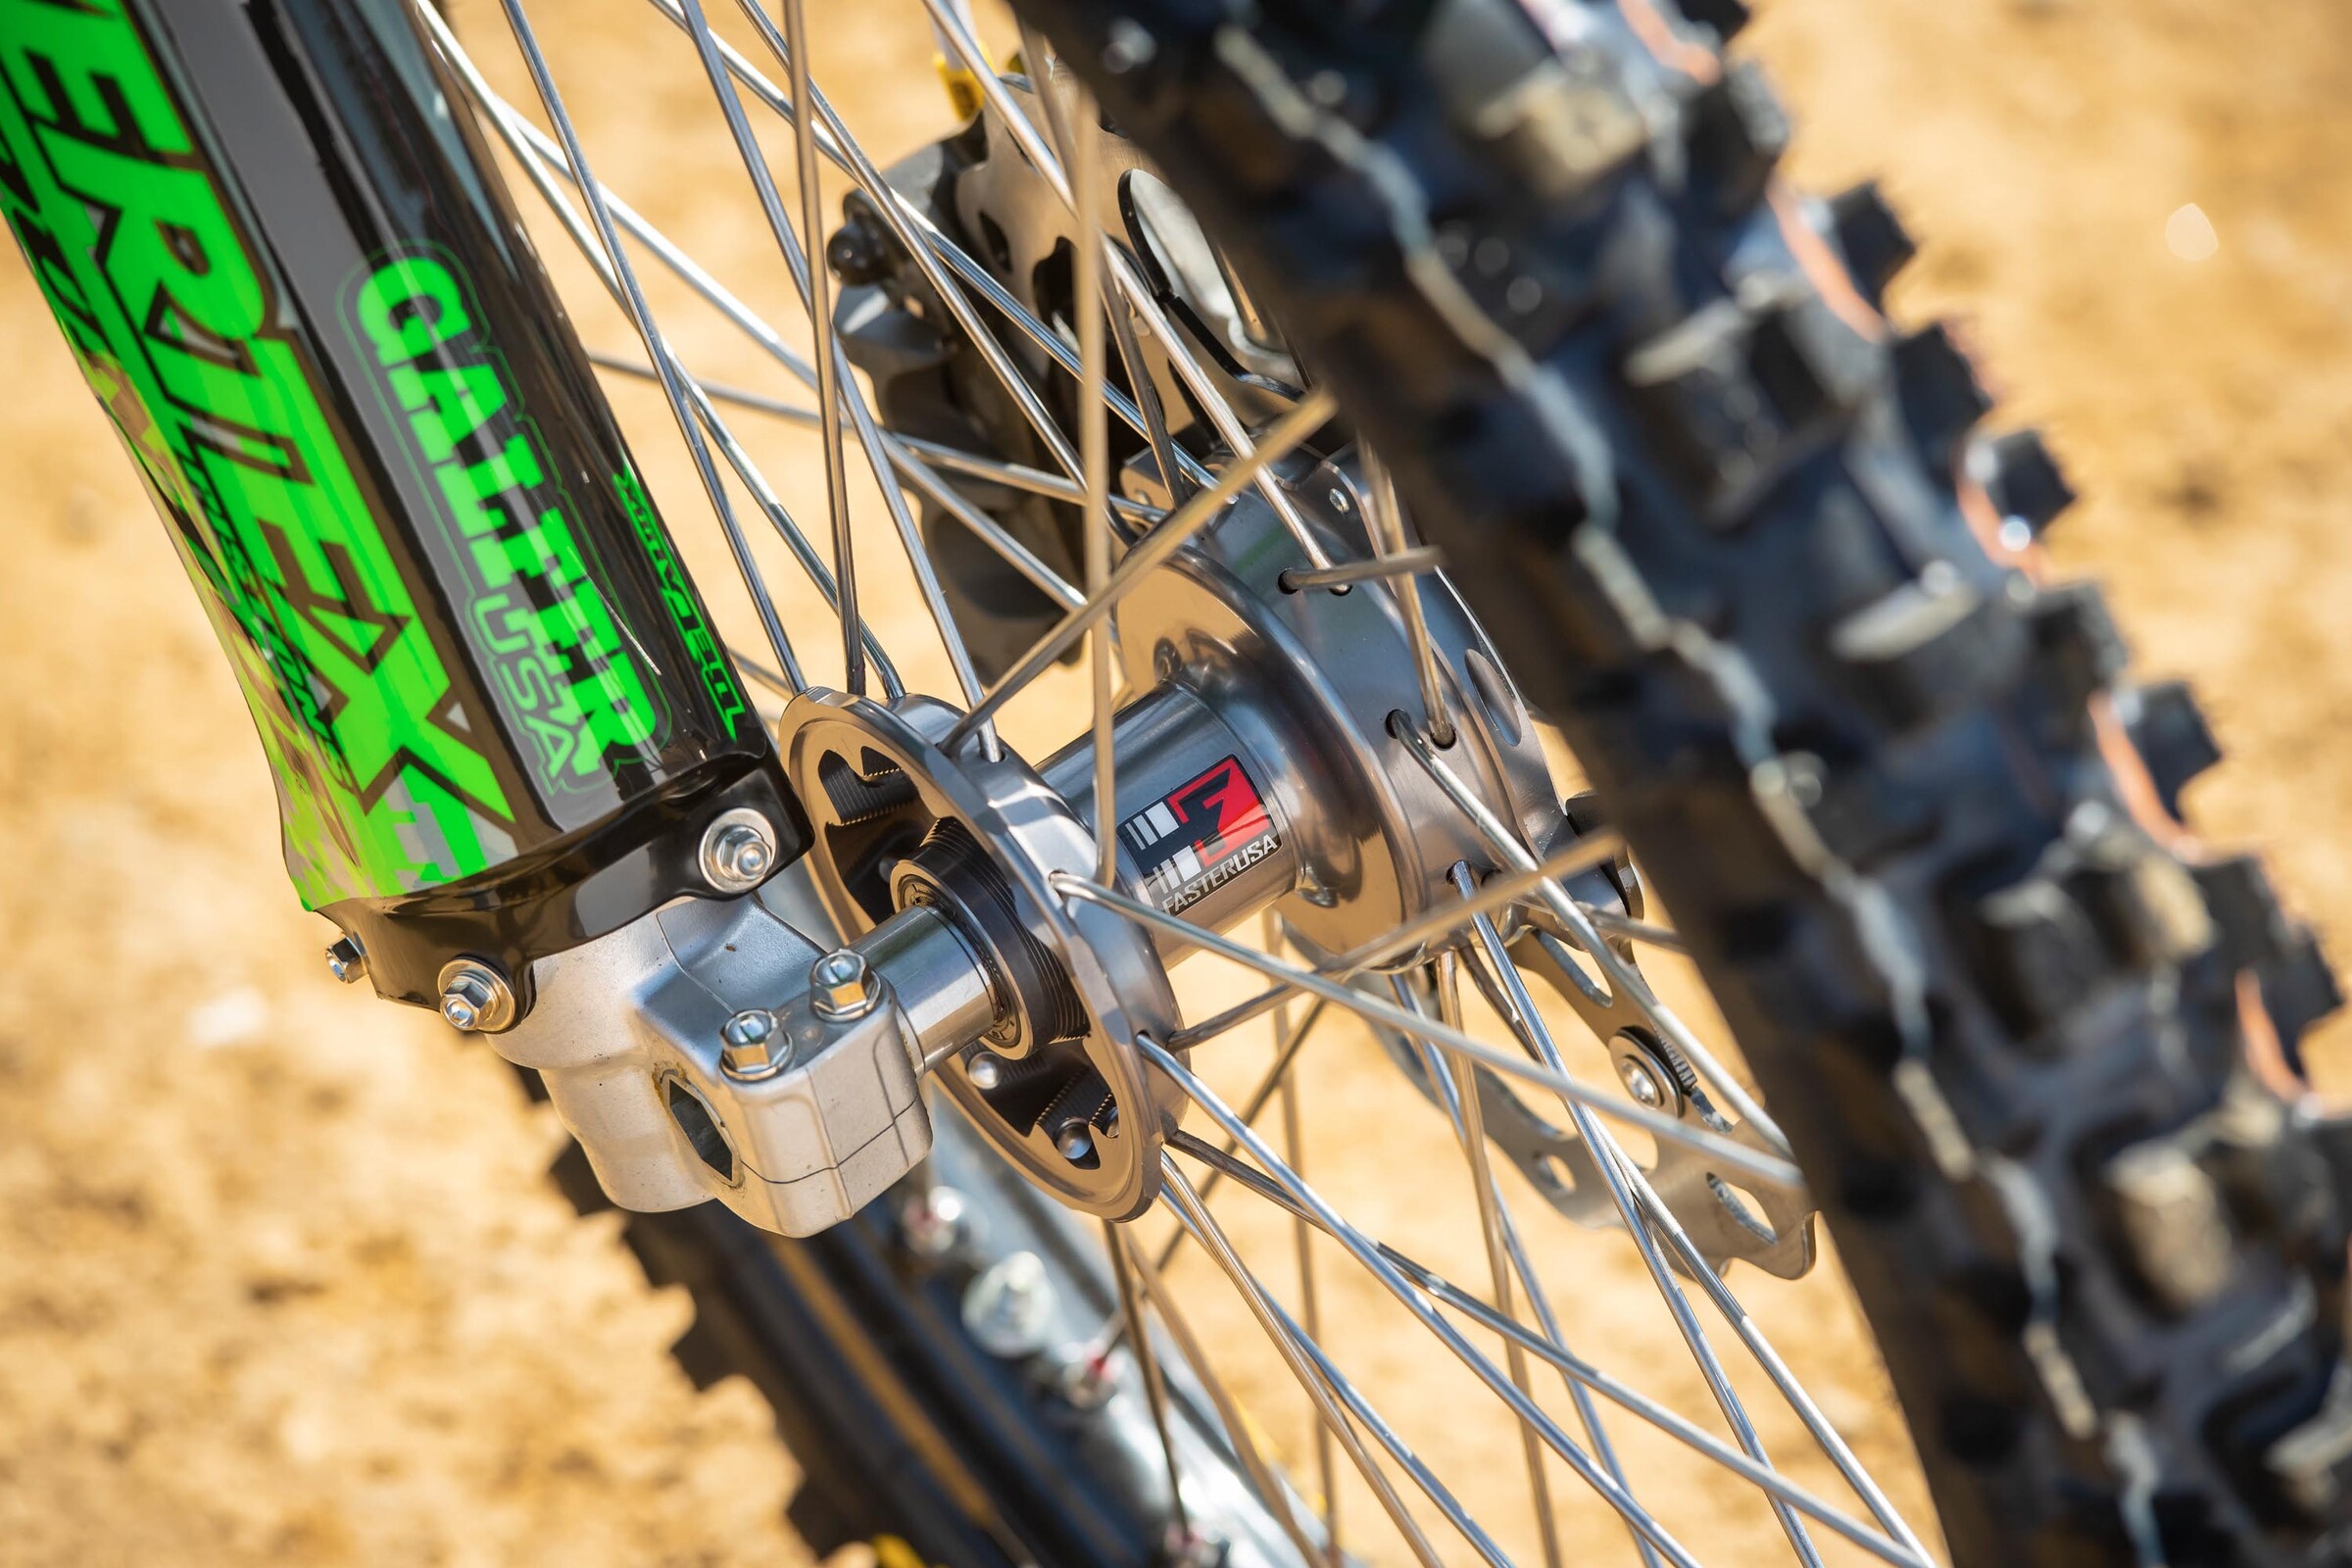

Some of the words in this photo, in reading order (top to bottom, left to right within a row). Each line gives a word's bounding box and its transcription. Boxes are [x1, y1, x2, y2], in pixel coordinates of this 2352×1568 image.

[0, 0, 516, 823] ERTEX
[175, 447, 351, 790] PISTONS
[356, 257, 657, 776] GALFER
[474, 593, 576, 778] USA
